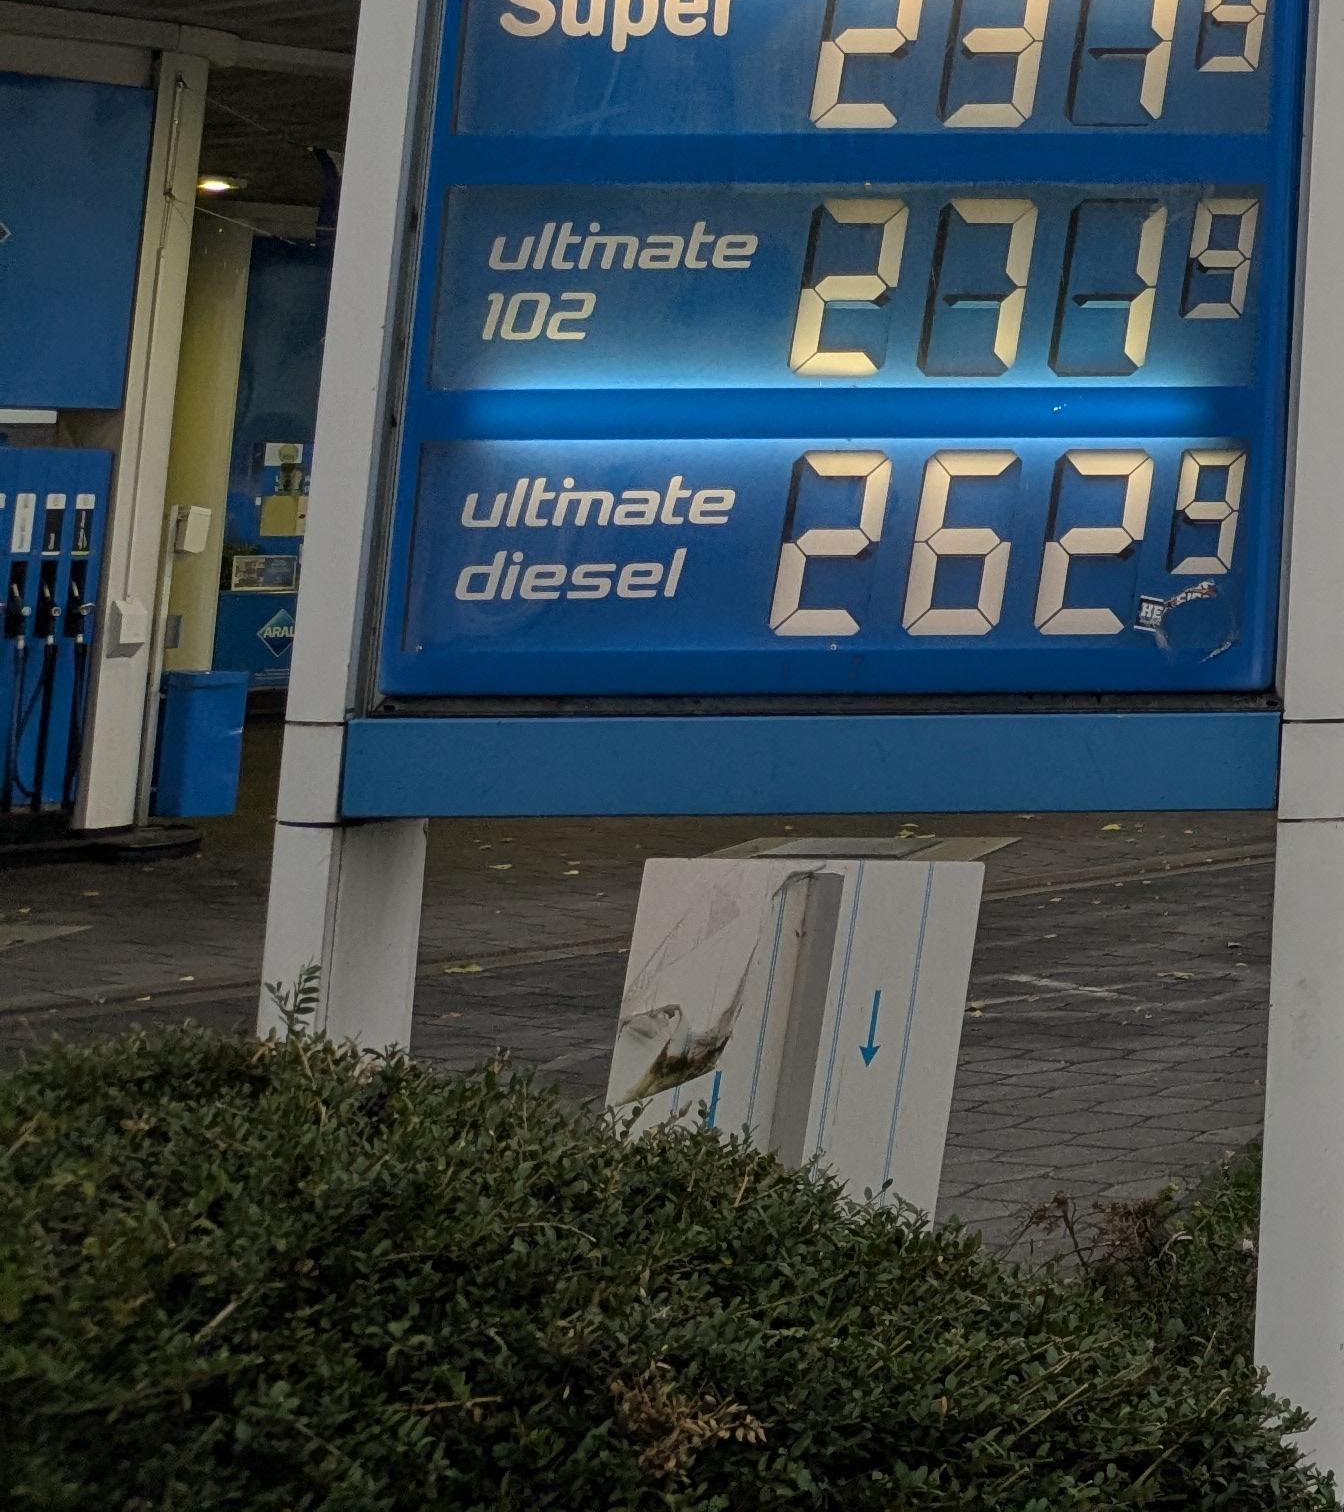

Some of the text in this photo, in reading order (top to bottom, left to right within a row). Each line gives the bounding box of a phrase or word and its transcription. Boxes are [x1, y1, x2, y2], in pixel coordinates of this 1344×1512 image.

[489, 222, 758, 271] ultimate
[481, 292, 596, 341] 102
[460, 476, 736, 528] ultimate
[456, 548, 687, 601] diesel
